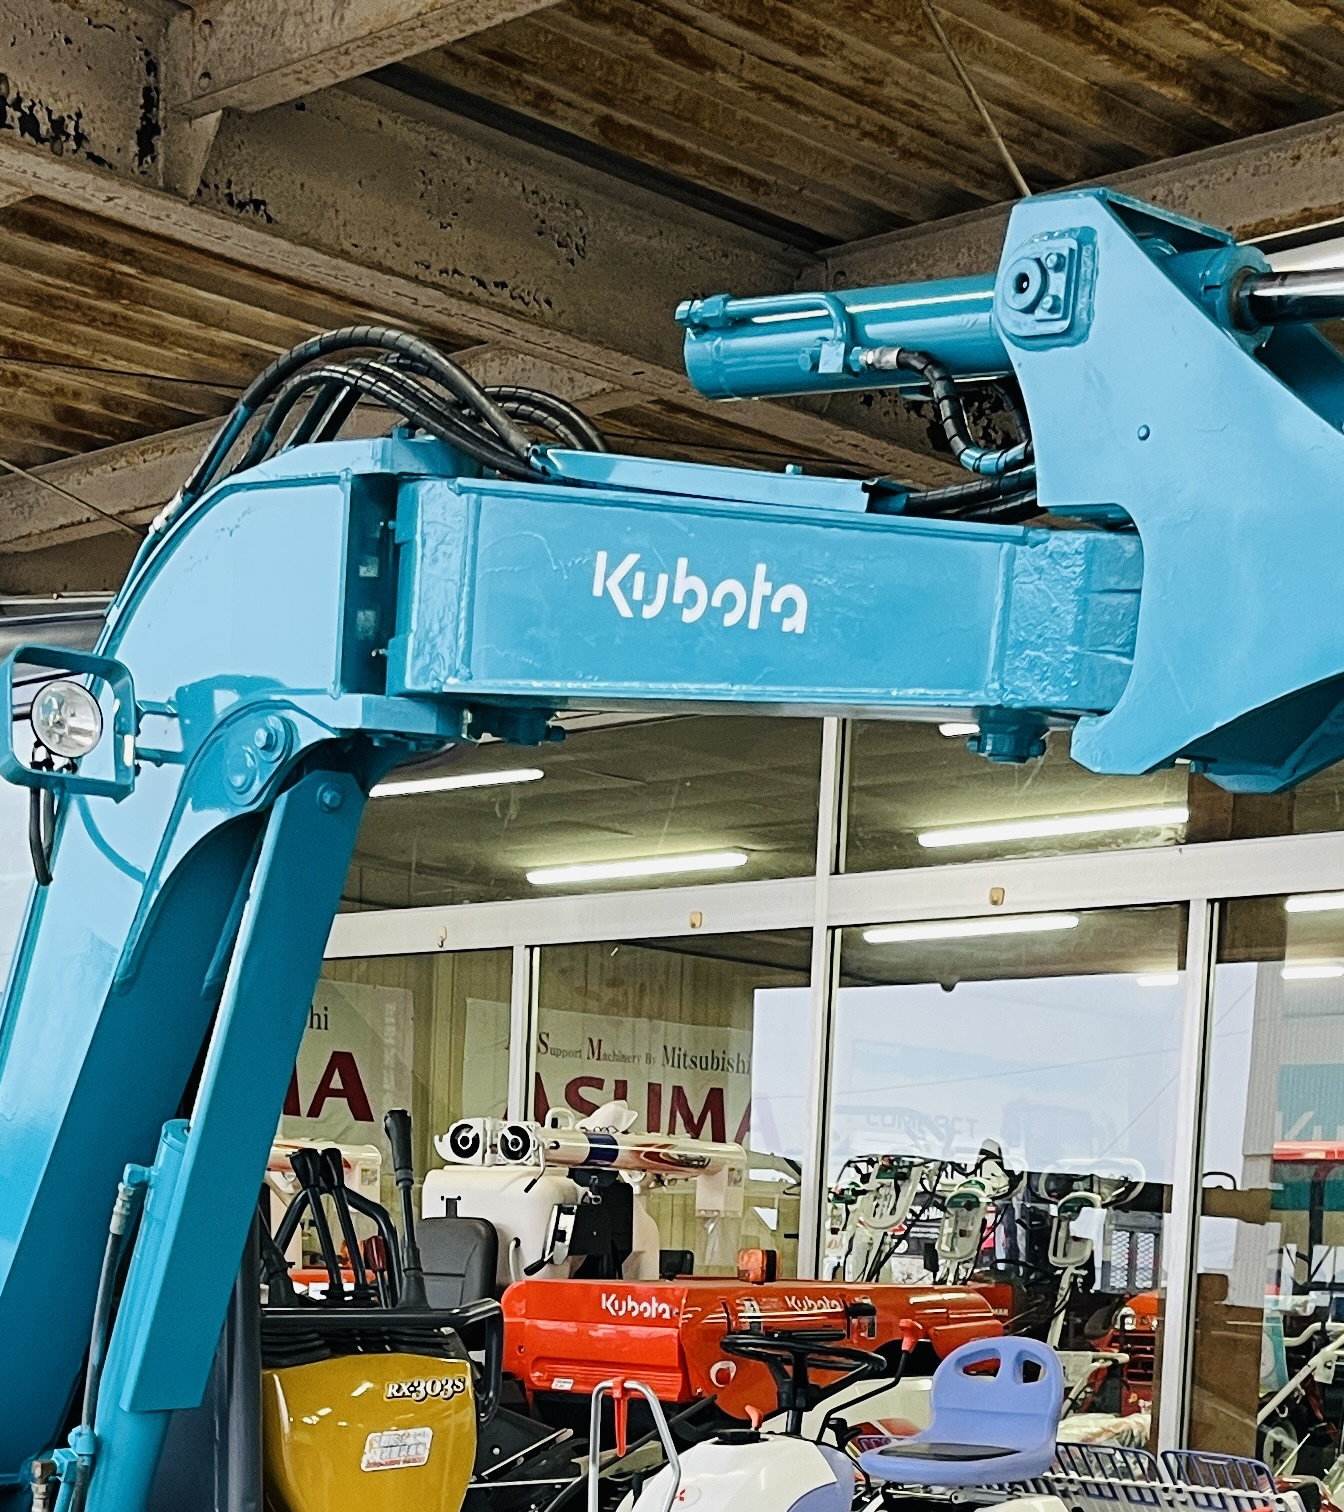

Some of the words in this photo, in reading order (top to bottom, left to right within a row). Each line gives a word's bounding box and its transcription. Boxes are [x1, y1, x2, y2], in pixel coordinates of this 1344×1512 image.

[592, 550, 808, 634] Kubota
[536, 1031, 582, 1059] Support
[662, 1045, 752, 1075] Mitsubishi
[601, 1293, 671, 1319] Kubota
[784, 1295, 843, 1313] Kubota
[385, 1376, 467, 1402] RX-303S
